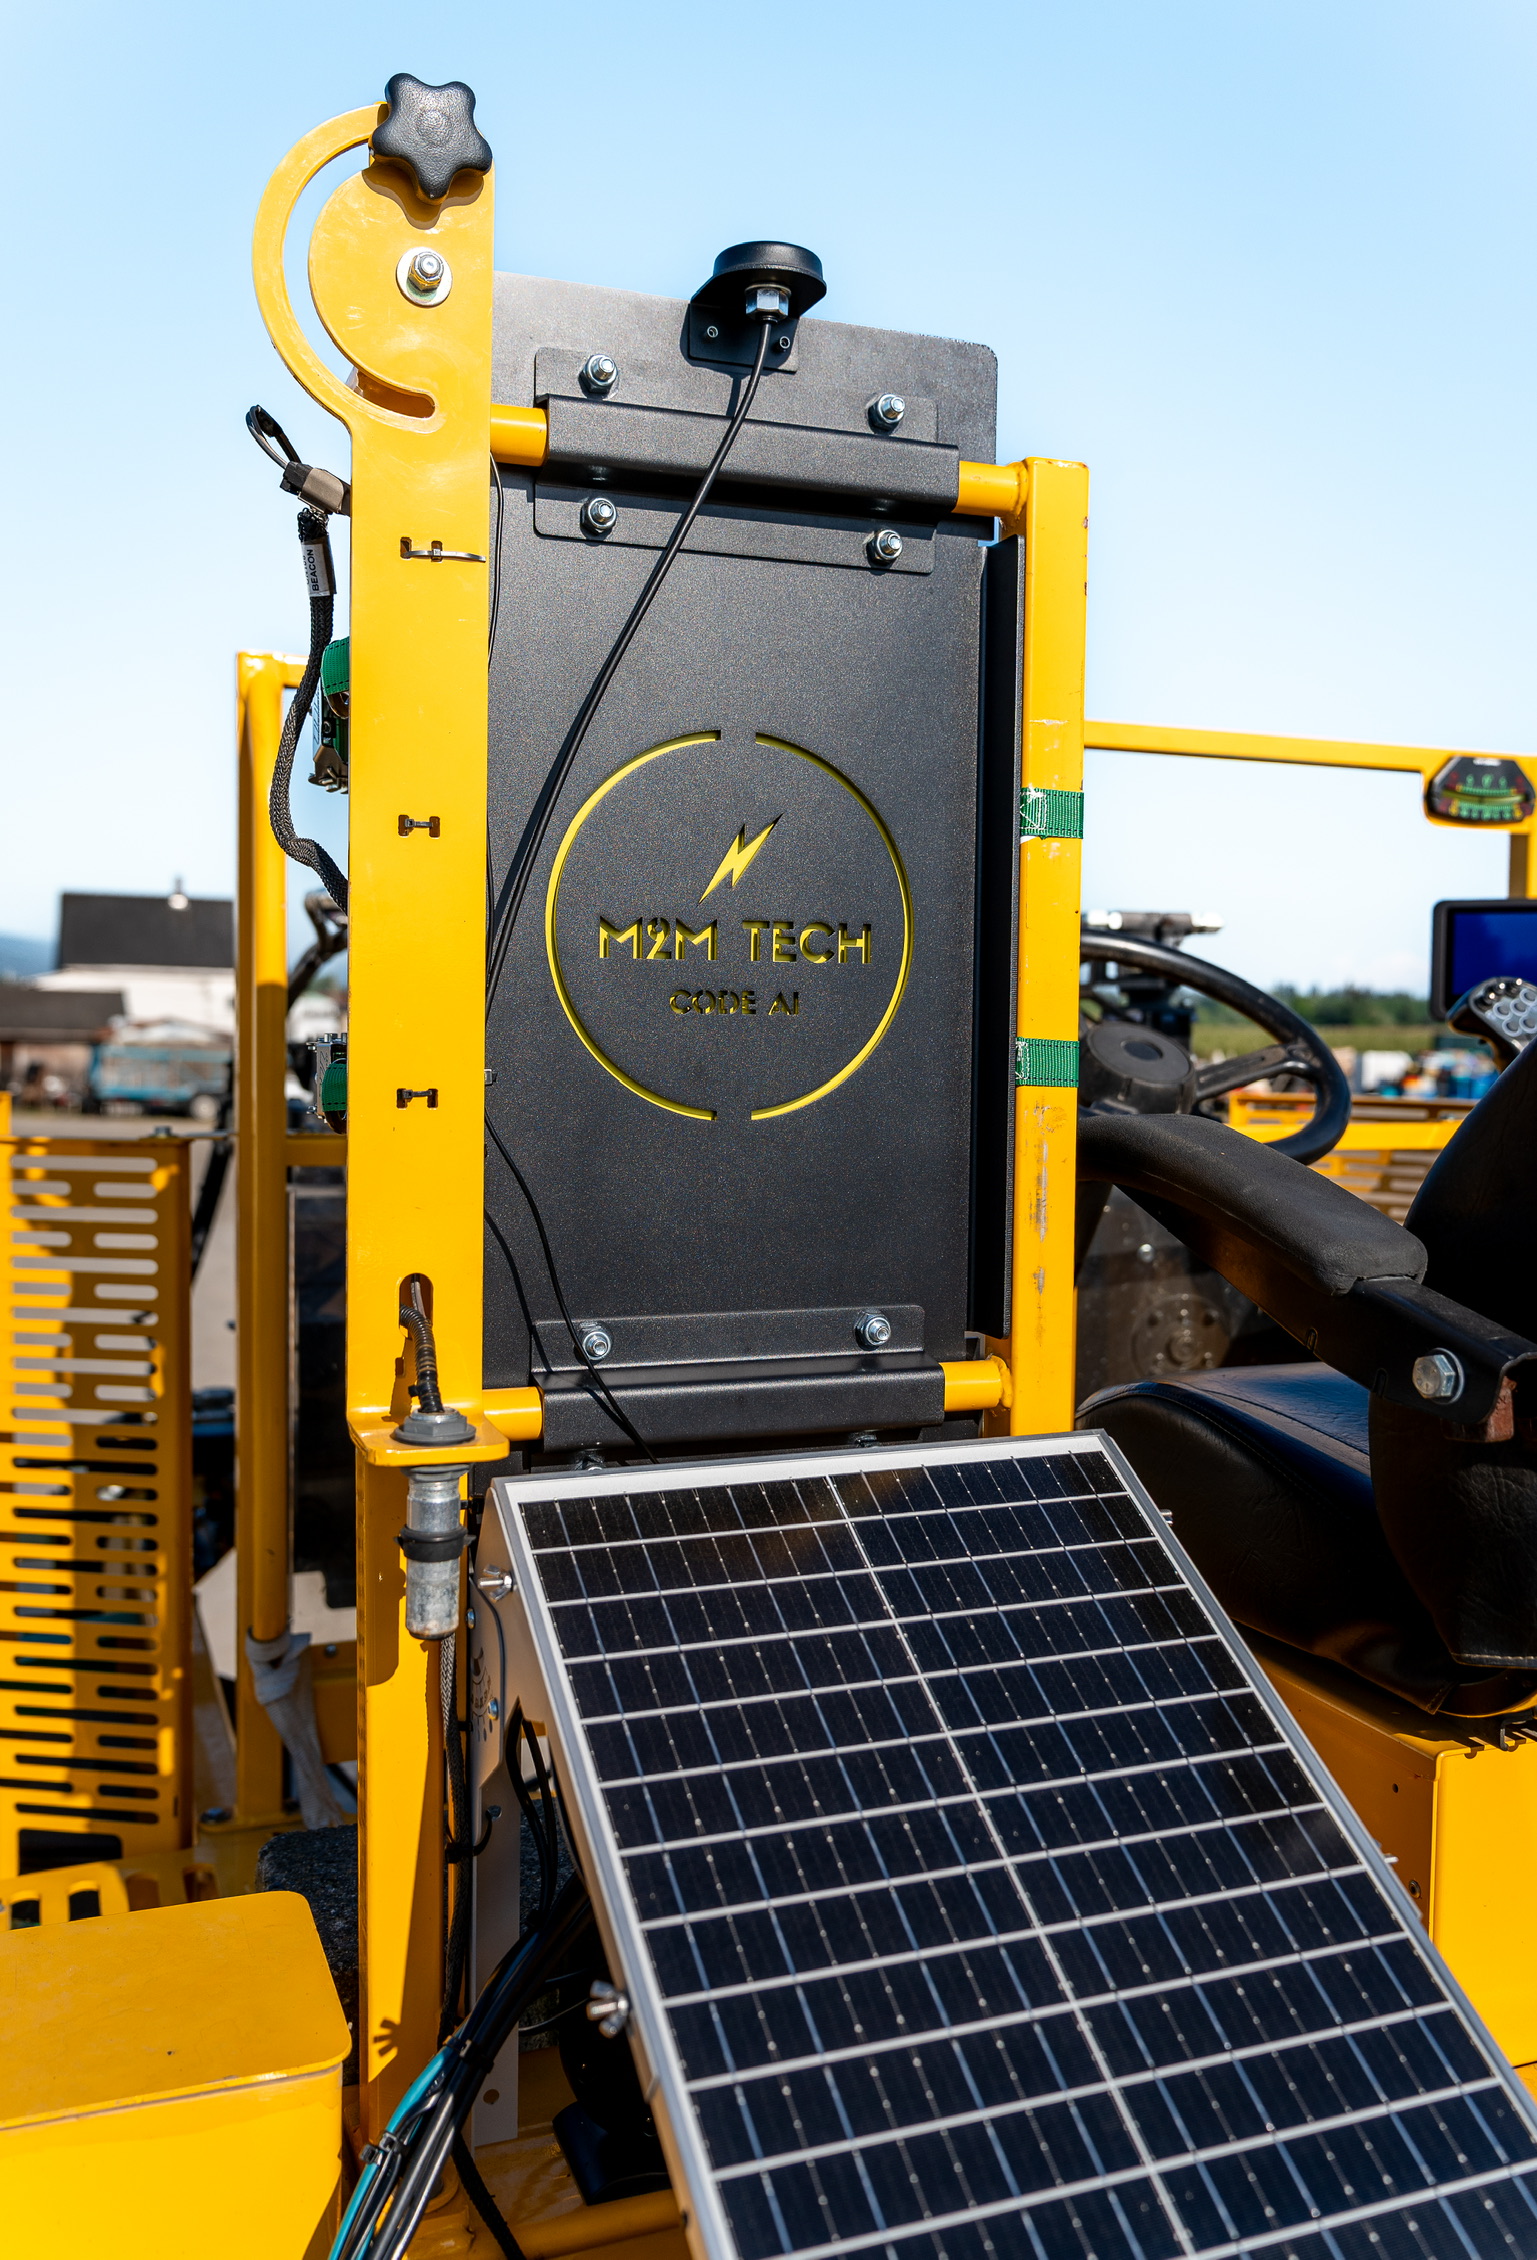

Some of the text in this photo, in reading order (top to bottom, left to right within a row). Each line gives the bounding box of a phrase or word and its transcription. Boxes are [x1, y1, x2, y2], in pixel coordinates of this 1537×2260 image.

[307, 549, 319, 591] BEACON
[599, 915, 872, 964] M2M TECH
[669, 989, 799, 1016] CODE AI
